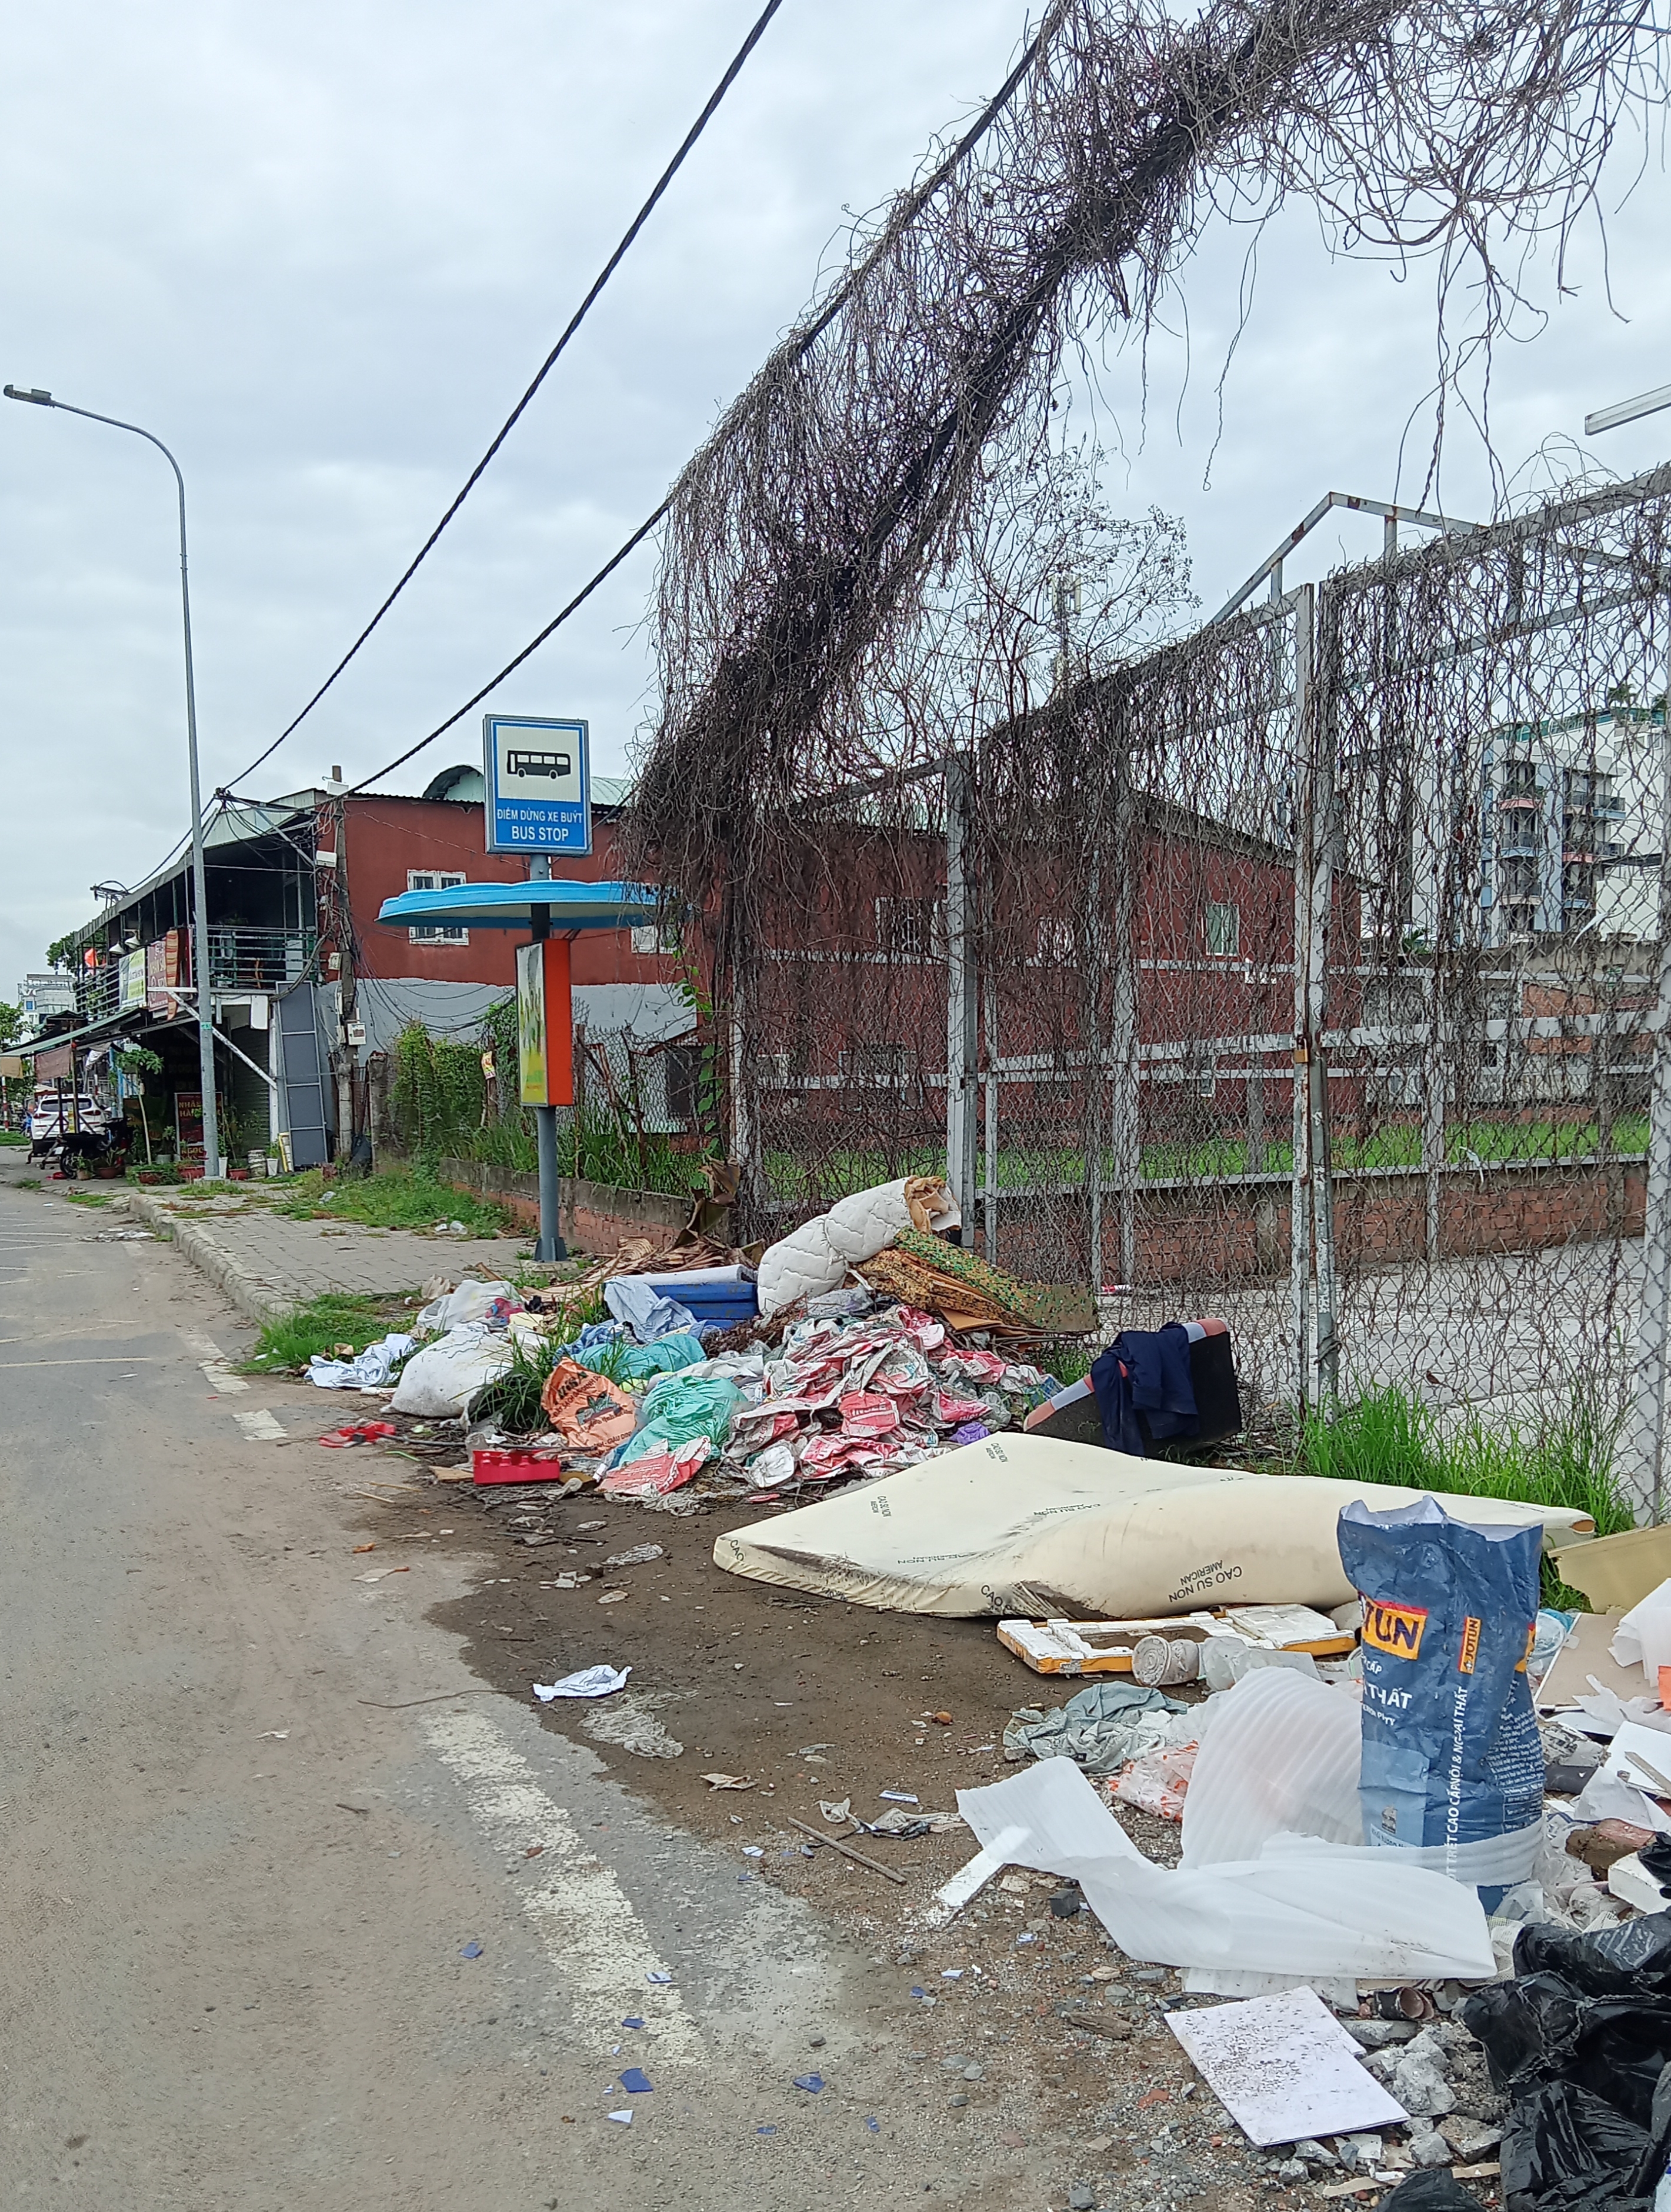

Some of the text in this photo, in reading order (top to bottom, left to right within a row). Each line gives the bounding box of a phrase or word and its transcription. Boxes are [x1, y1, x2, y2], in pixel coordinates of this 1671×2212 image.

[521, 807, 545, 822] DỪNG
[548, 811, 558, 822] XE
[561, 809, 582, 824] BUÝT
[512, 826, 569, 842] BUS STOP
[730, 1540, 744, 1561] CAO
[1168, 1565, 1242, 1603] CAO SU NON
[1180, 1560, 1223, 1586] AMERICAN
[980, 1584, 1003, 1607] CAO
[1364, 1601, 1419, 1650] TUN
[1465, 1619, 1479, 1660] JOTUN
[1453, 1687, 1468, 1718] THẤT
[1453, 1718, 1466, 1754] NGẠI
[1452, 1755, 1462, 1764] &
[1446, 1807, 1460, 1834] CAO
